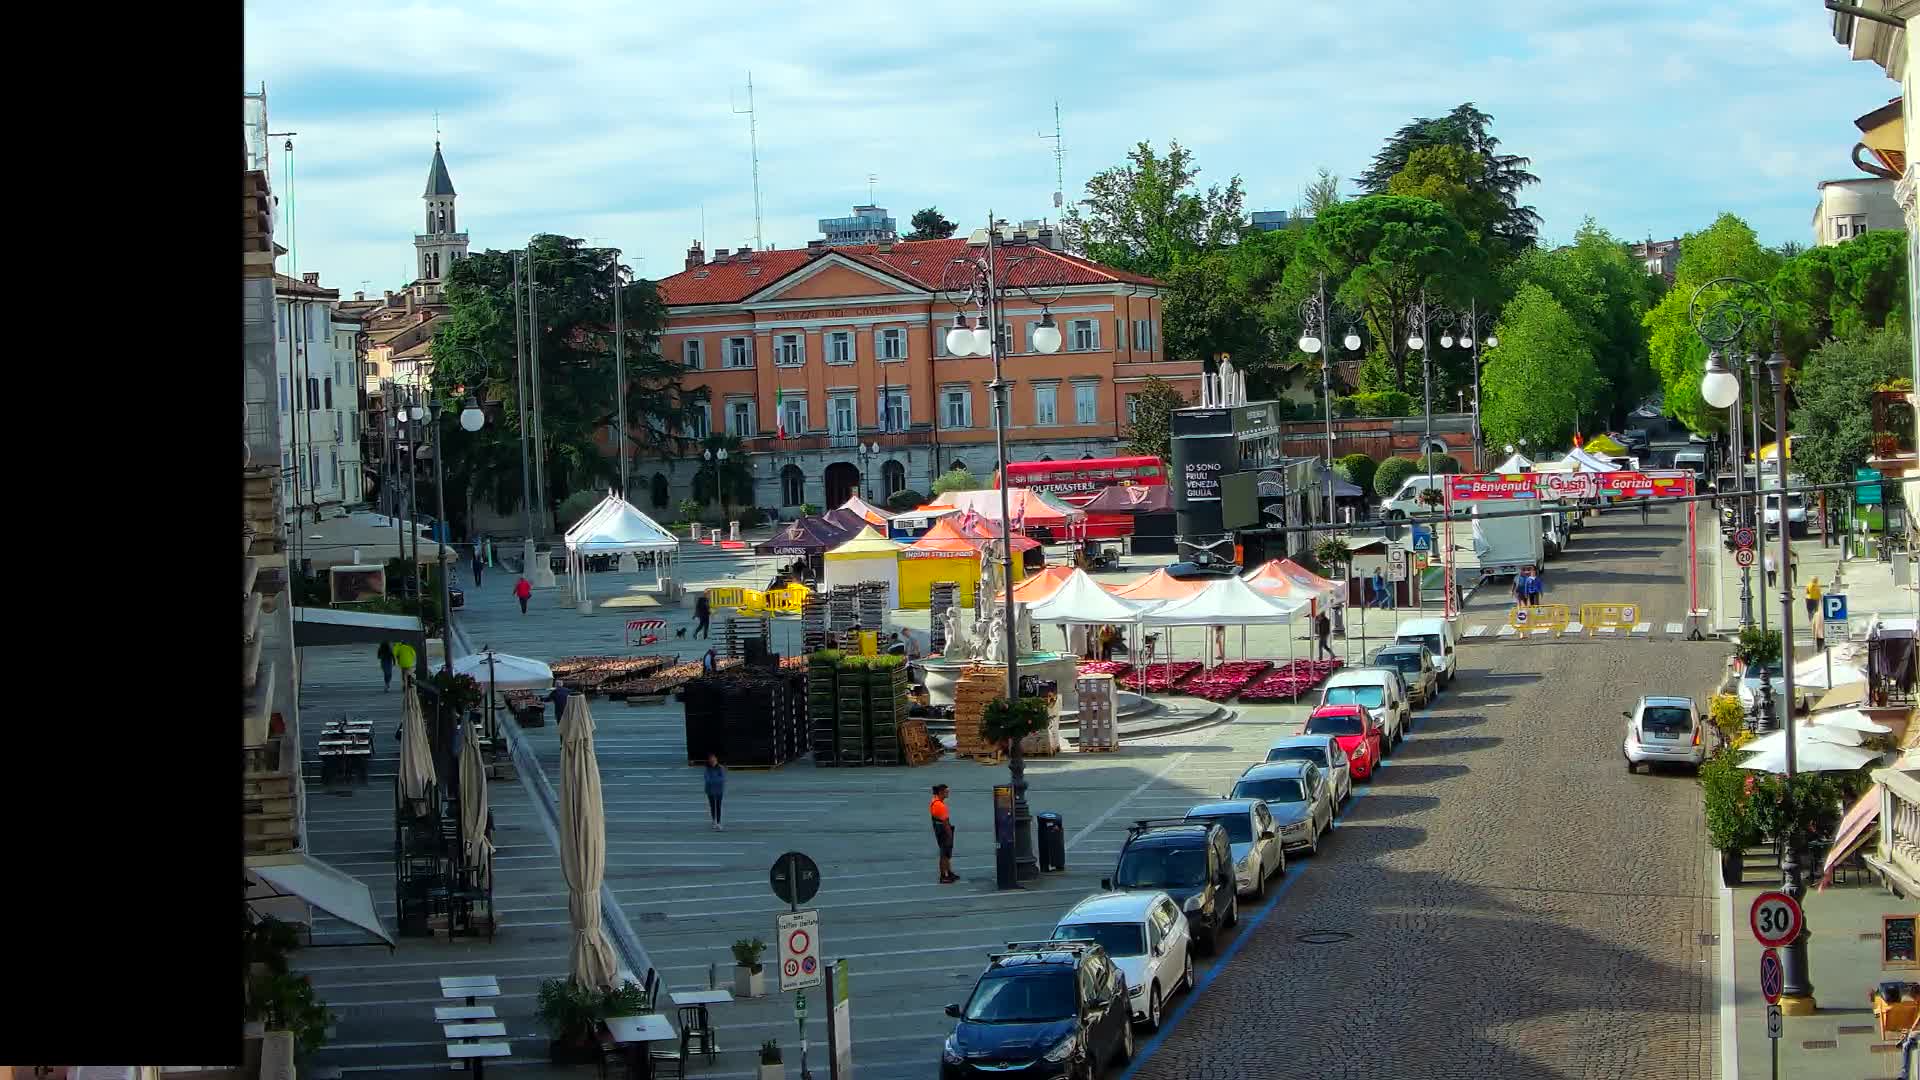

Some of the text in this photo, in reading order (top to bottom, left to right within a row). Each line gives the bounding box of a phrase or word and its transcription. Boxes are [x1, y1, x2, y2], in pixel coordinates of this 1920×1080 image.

[1196, 463, 1221, 472] SONO
[1186, 472, 1208, 481] FRIULI
[1186, 480, 1219, 489] VENEZIA
[1472, 480, 1531, 492] Benvenuti
[1611, 478, 1653, 489] Gorizia
[1187, 488, 1212, 497] GIULIA
[773, 547, 807, 555] GUINNESS
[1740, 553, 1751, 562] 20
[1828, 598, 1842, 618] P
[1759, 907, 1790, 933] 30
